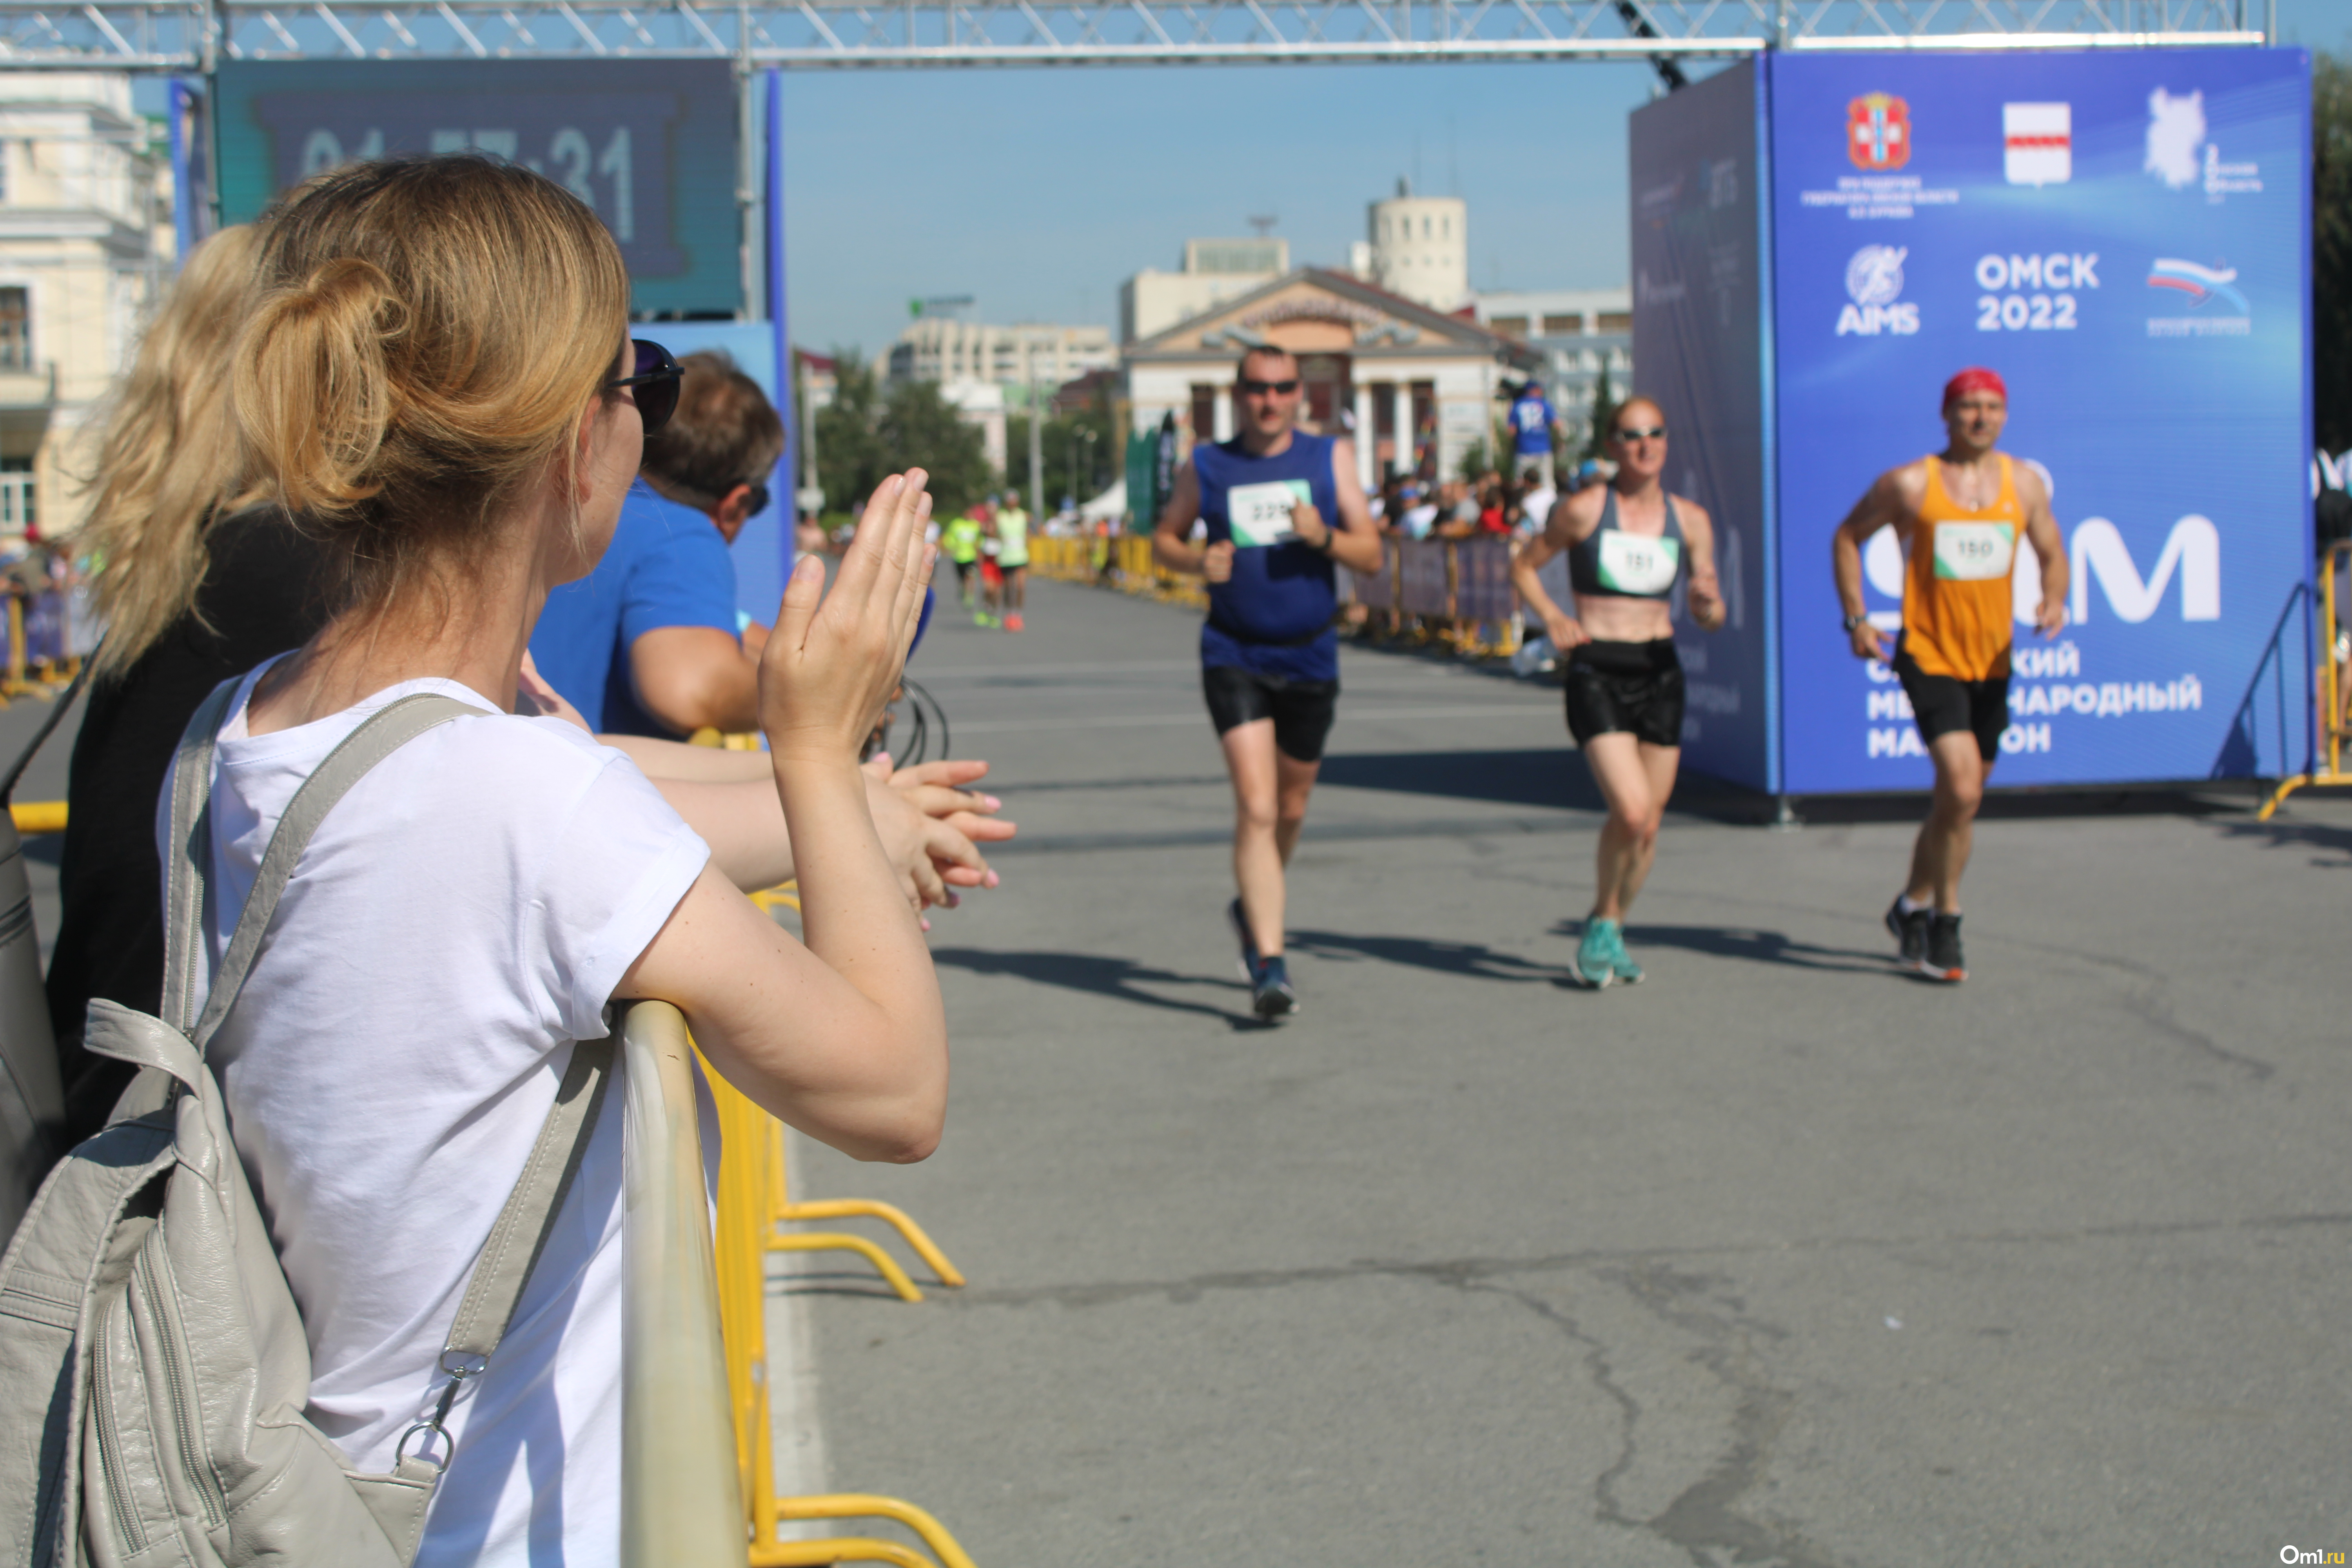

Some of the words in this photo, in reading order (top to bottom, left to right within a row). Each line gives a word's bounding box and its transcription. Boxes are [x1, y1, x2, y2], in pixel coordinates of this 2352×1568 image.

[1976, 254, 2100, 290] ОМСК
[1837, 303, 1920, 336] AIMS
[1977, 294, 2077, 331] 2022
[1867, 723, 2050, 758] МАОН
